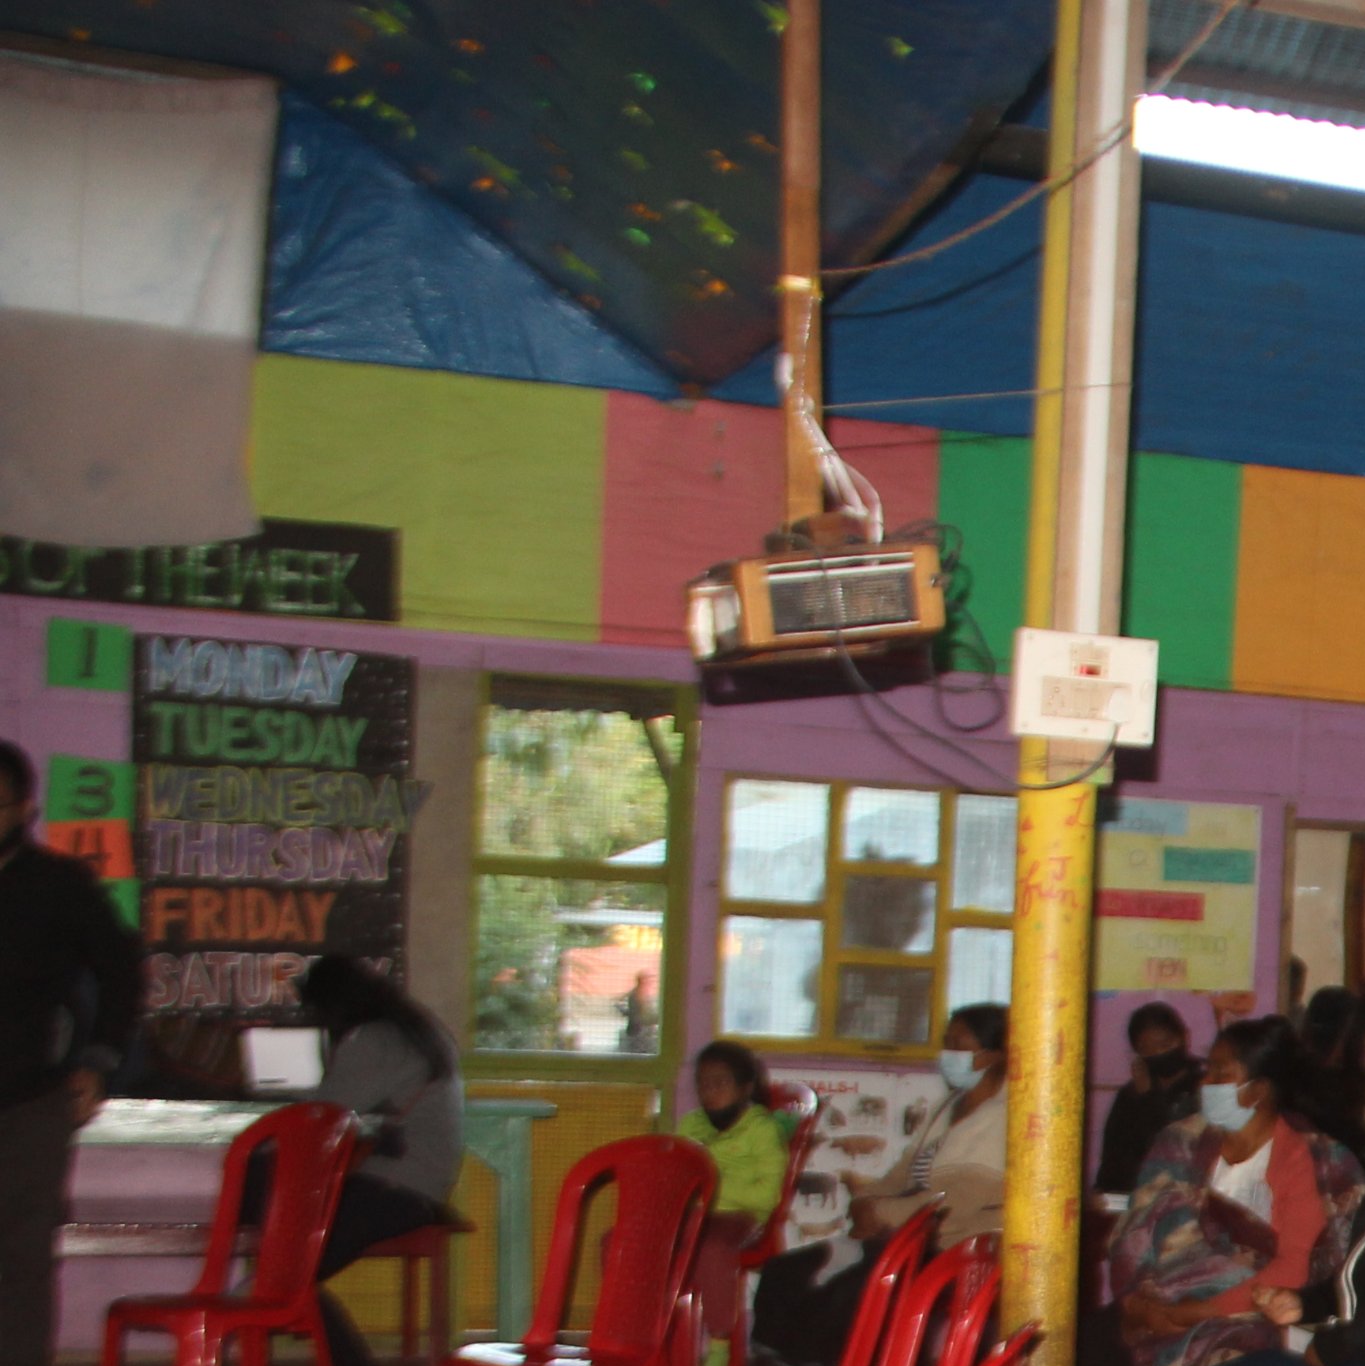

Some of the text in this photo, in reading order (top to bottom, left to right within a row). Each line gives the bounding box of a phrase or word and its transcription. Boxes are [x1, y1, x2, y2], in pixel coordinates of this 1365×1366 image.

[238, 547, 366, 615] WEEK
[148, 635, 359, 706] MONDAY
[149, 701, 369, 768] TUESDAY
[71, 762, 115, 816] 3
[147, 763, 436, 831] WEDNESDAY
[149, 819, 398, 882] THURSDAY
[146, 886, 339, 945] FRIDAY
